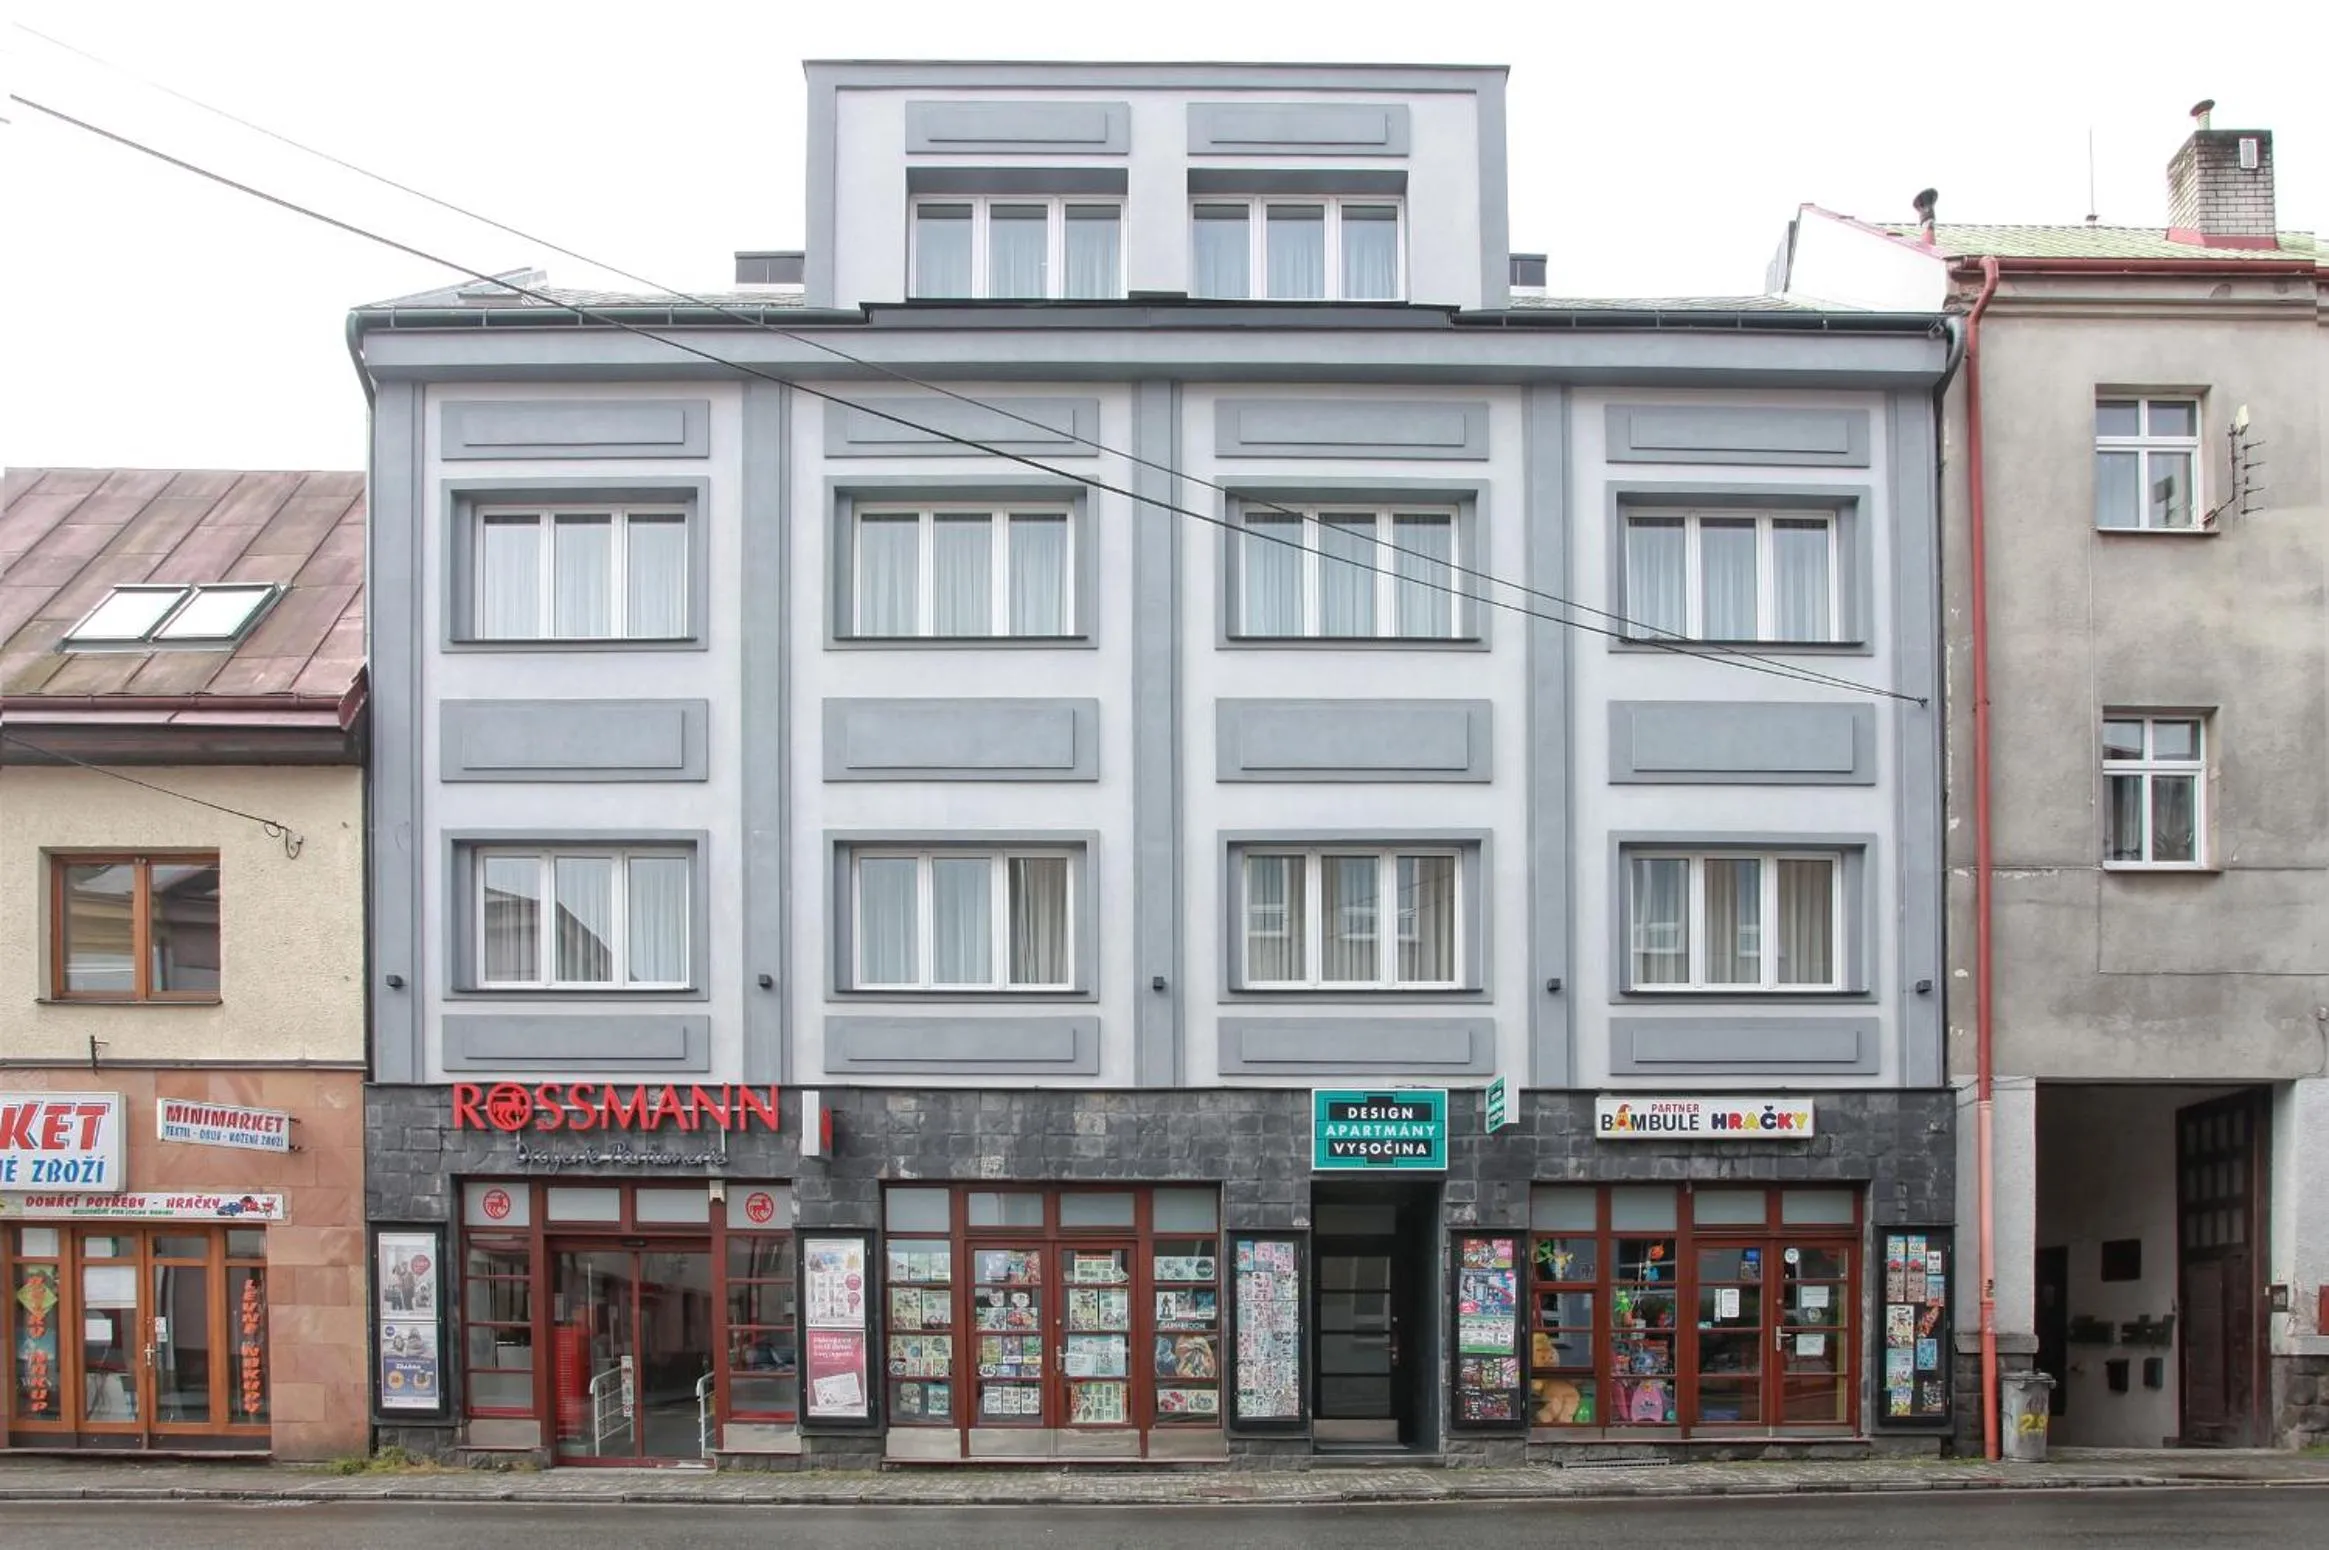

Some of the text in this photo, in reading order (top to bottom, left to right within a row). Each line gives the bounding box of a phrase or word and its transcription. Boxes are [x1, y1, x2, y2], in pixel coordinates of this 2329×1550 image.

[452, 1082, 780, 1132] ROSSMANN
[1348, 1107, 1413, 1119] DESIGN
[1652, 1104, 1699, 1113] PARTNER
[166, 1104, 284, 1133] MINIMARKET
[1600, 1105, 1808, 1131] BAMBULE HRAČKY
[1325, 1122, 1436, 1136] APARTMÁNY
[1334, 1140, 1427, 1154] VYSOČINA
[32, 1155, 105, 1183] ZBOŽÍ
[25, 1194, 80, 1208] DOMÁCÍ
[86, 1193, 146, 1208] POTŘEBY
[166, 1195, 221, 1208] HRAČKY
